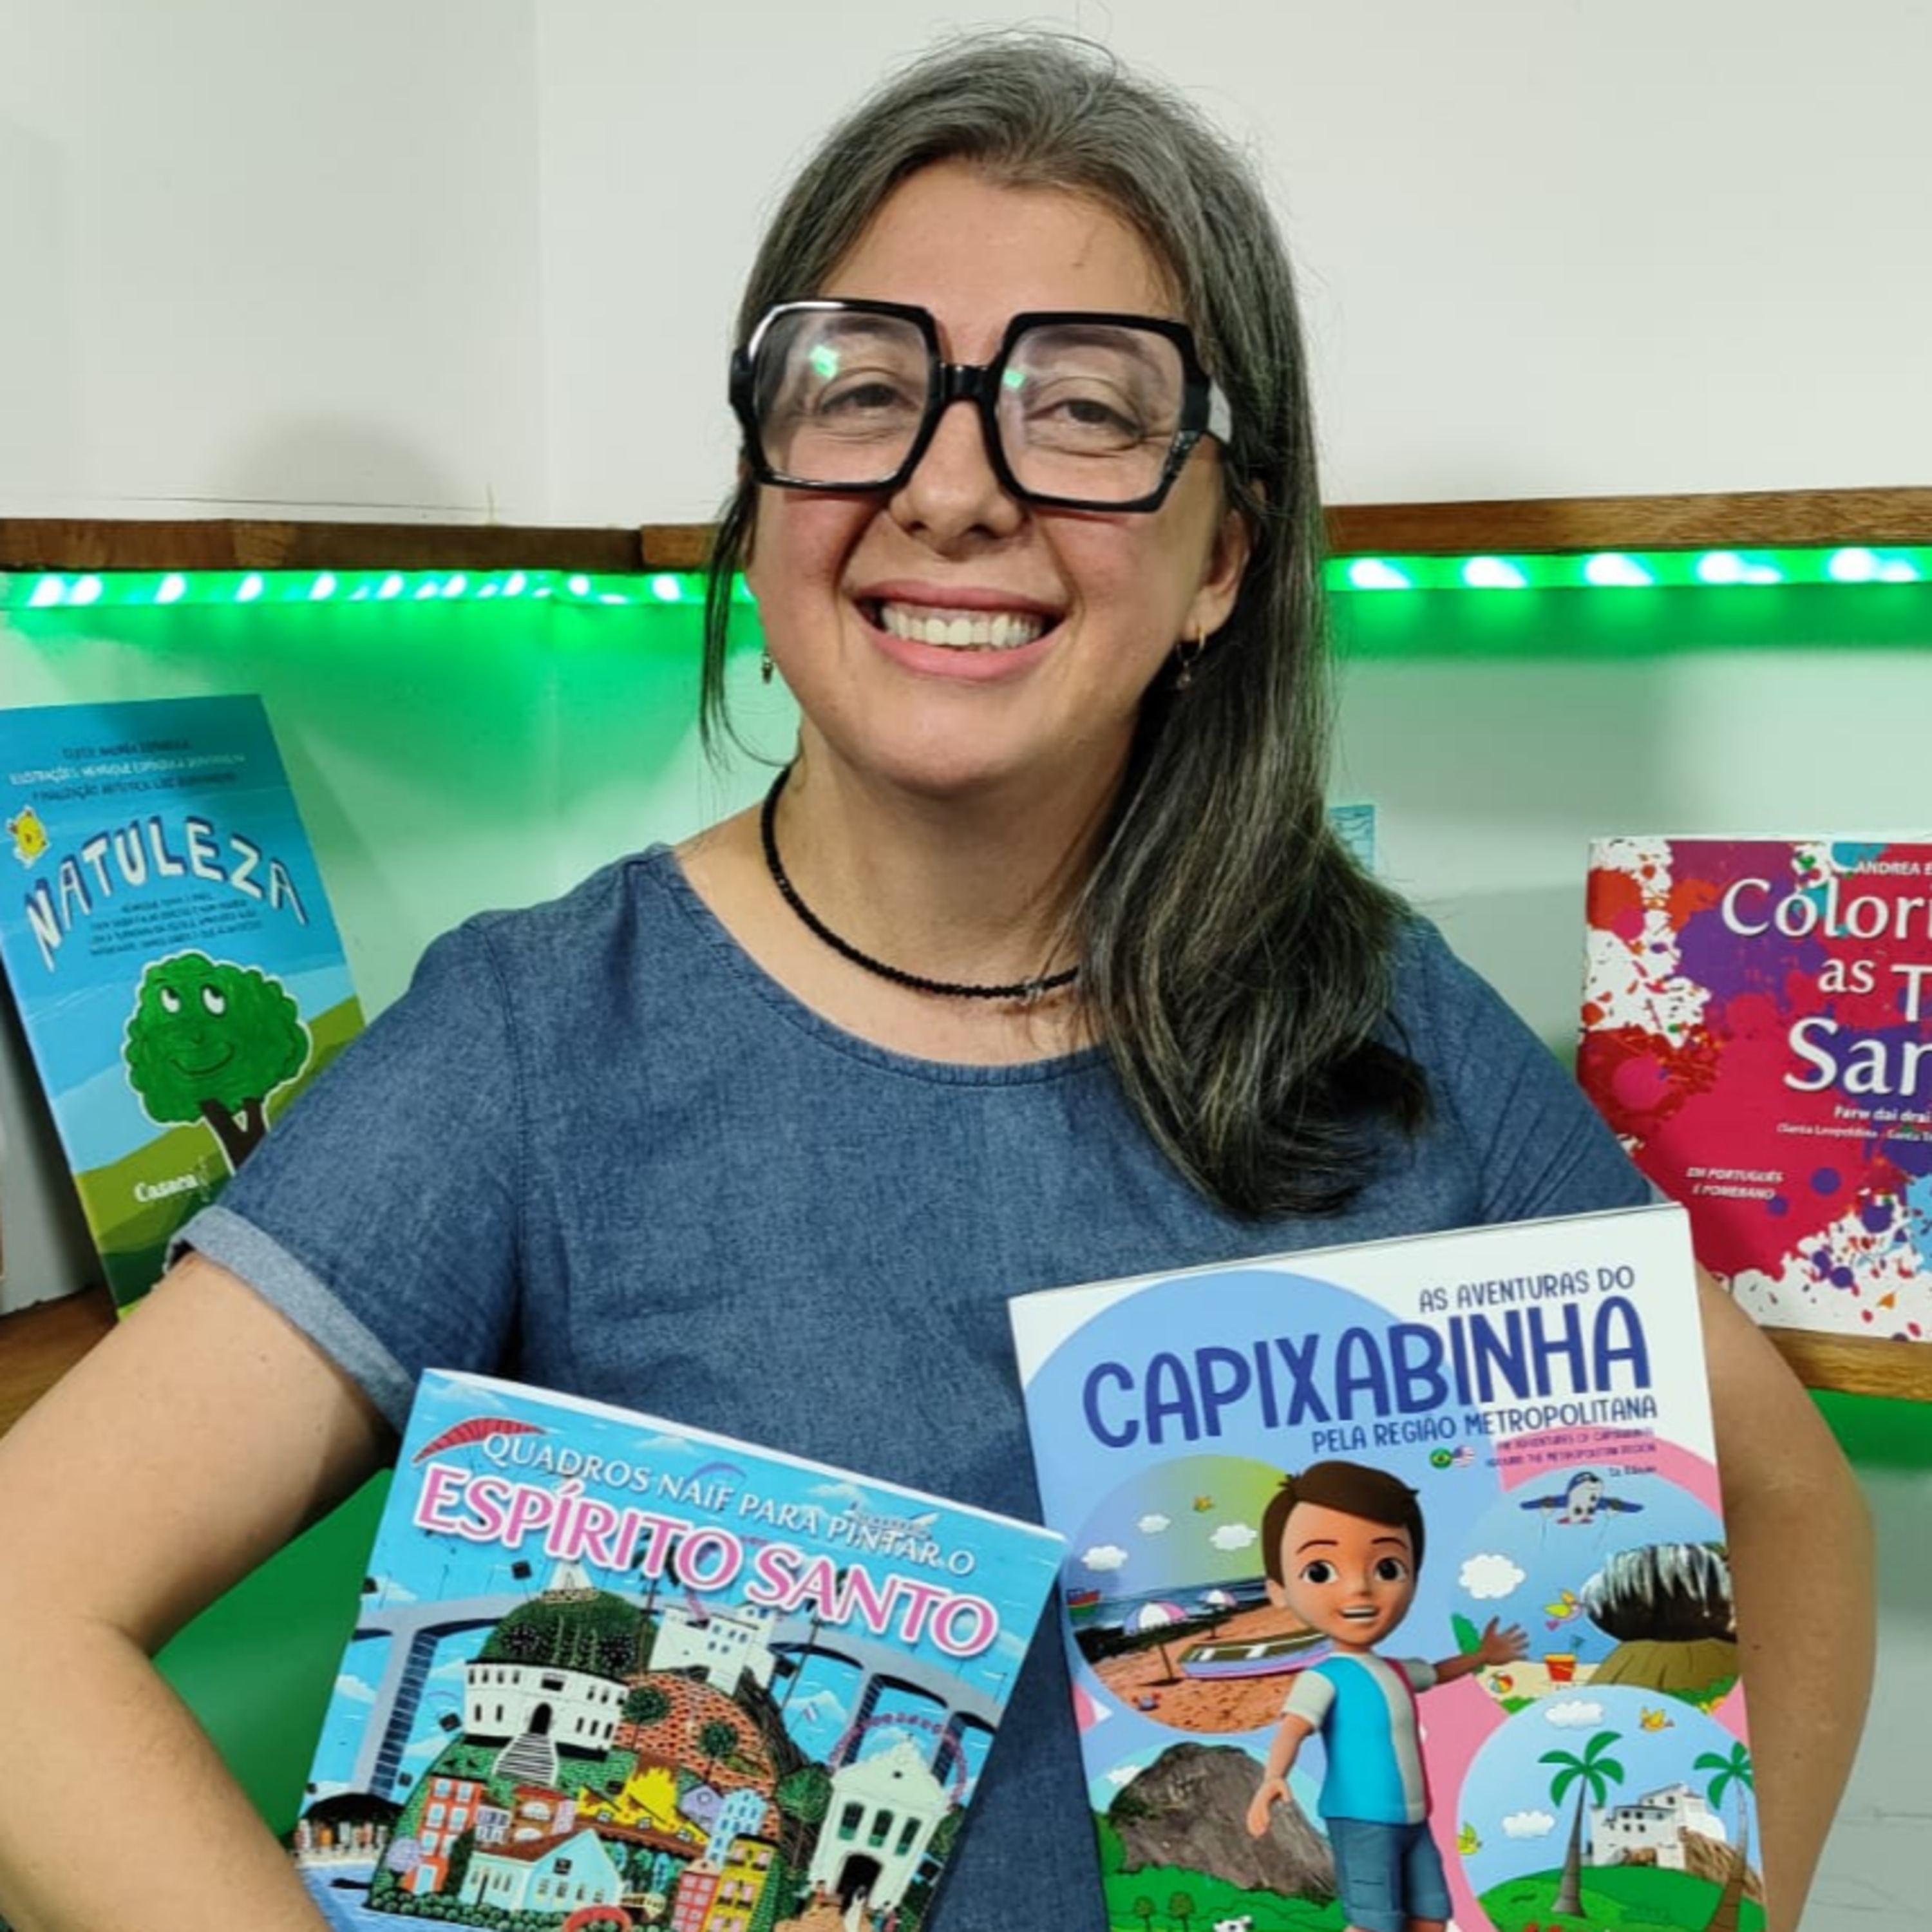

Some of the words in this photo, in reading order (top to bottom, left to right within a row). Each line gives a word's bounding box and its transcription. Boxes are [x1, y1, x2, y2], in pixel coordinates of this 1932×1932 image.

[25, 816, 309, 972] NATULEZA
[1817, 958, 1875, 994] as
[1419, 1287, 1448, 1313] AS
[1457, 1269, 1589, 1308] AVENTURAS
[1598, 1265, 1635, 1291] DO
[1082, 1295, 1651, 1448] CAPIXABINHA
[1311, 1425, 1367, 1454] PELA
[1373, 1414, 1457, 1447] REGIÃO
[1464, 1395, 1658, 1437] METROPOLITANA
[415, 1463, 743, 1590] ESPÍRITO
[745, 1542, 999, 1657] SANTO
[483, 1432, 651, 1493] QUADROS
[739, 1493, 818, 1535] PARA
[826, 1514, 944, 1568] PINTAR
[947, 1549, 976, 1575] O
